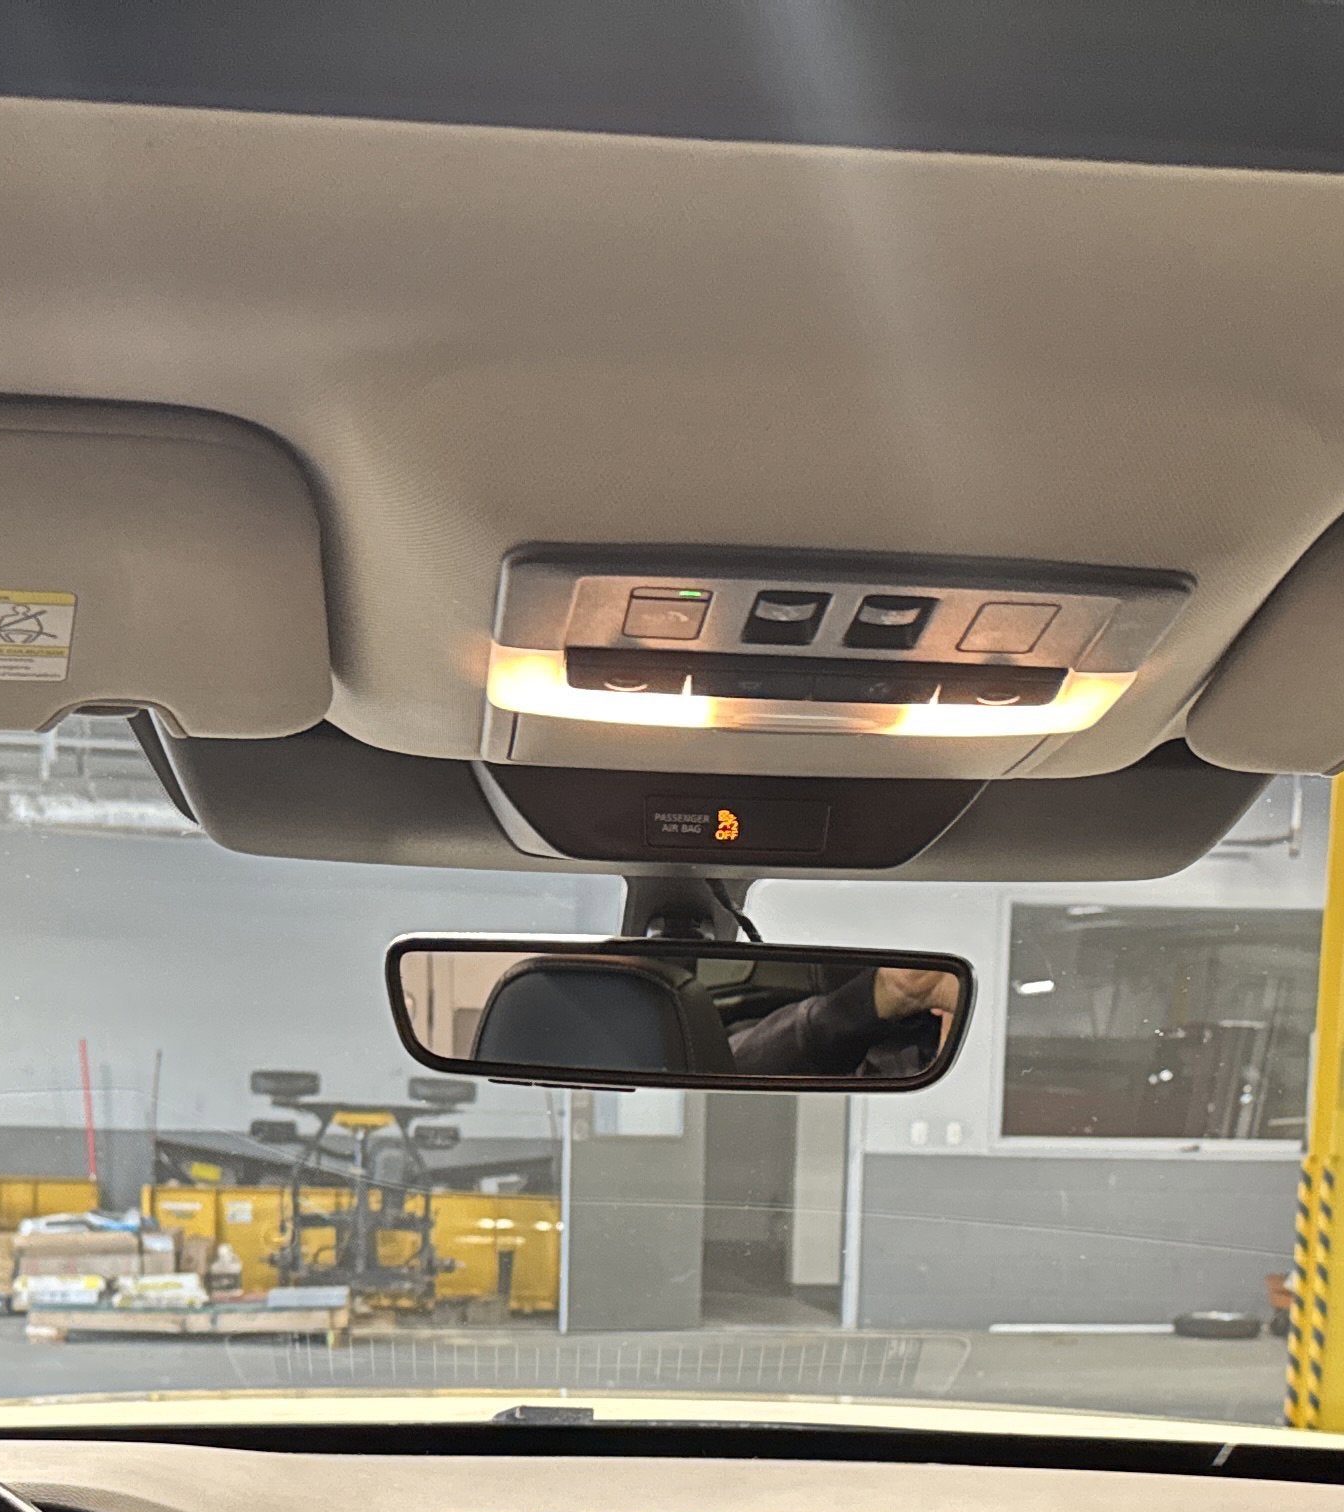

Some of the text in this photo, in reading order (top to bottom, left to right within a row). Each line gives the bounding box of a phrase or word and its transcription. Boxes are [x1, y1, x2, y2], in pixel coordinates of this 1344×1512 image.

[654, 812, 710, 824] PASSENGER
[661, 823, 702, 834] AIR BAG
[715, 829, 739, 841] OFF
